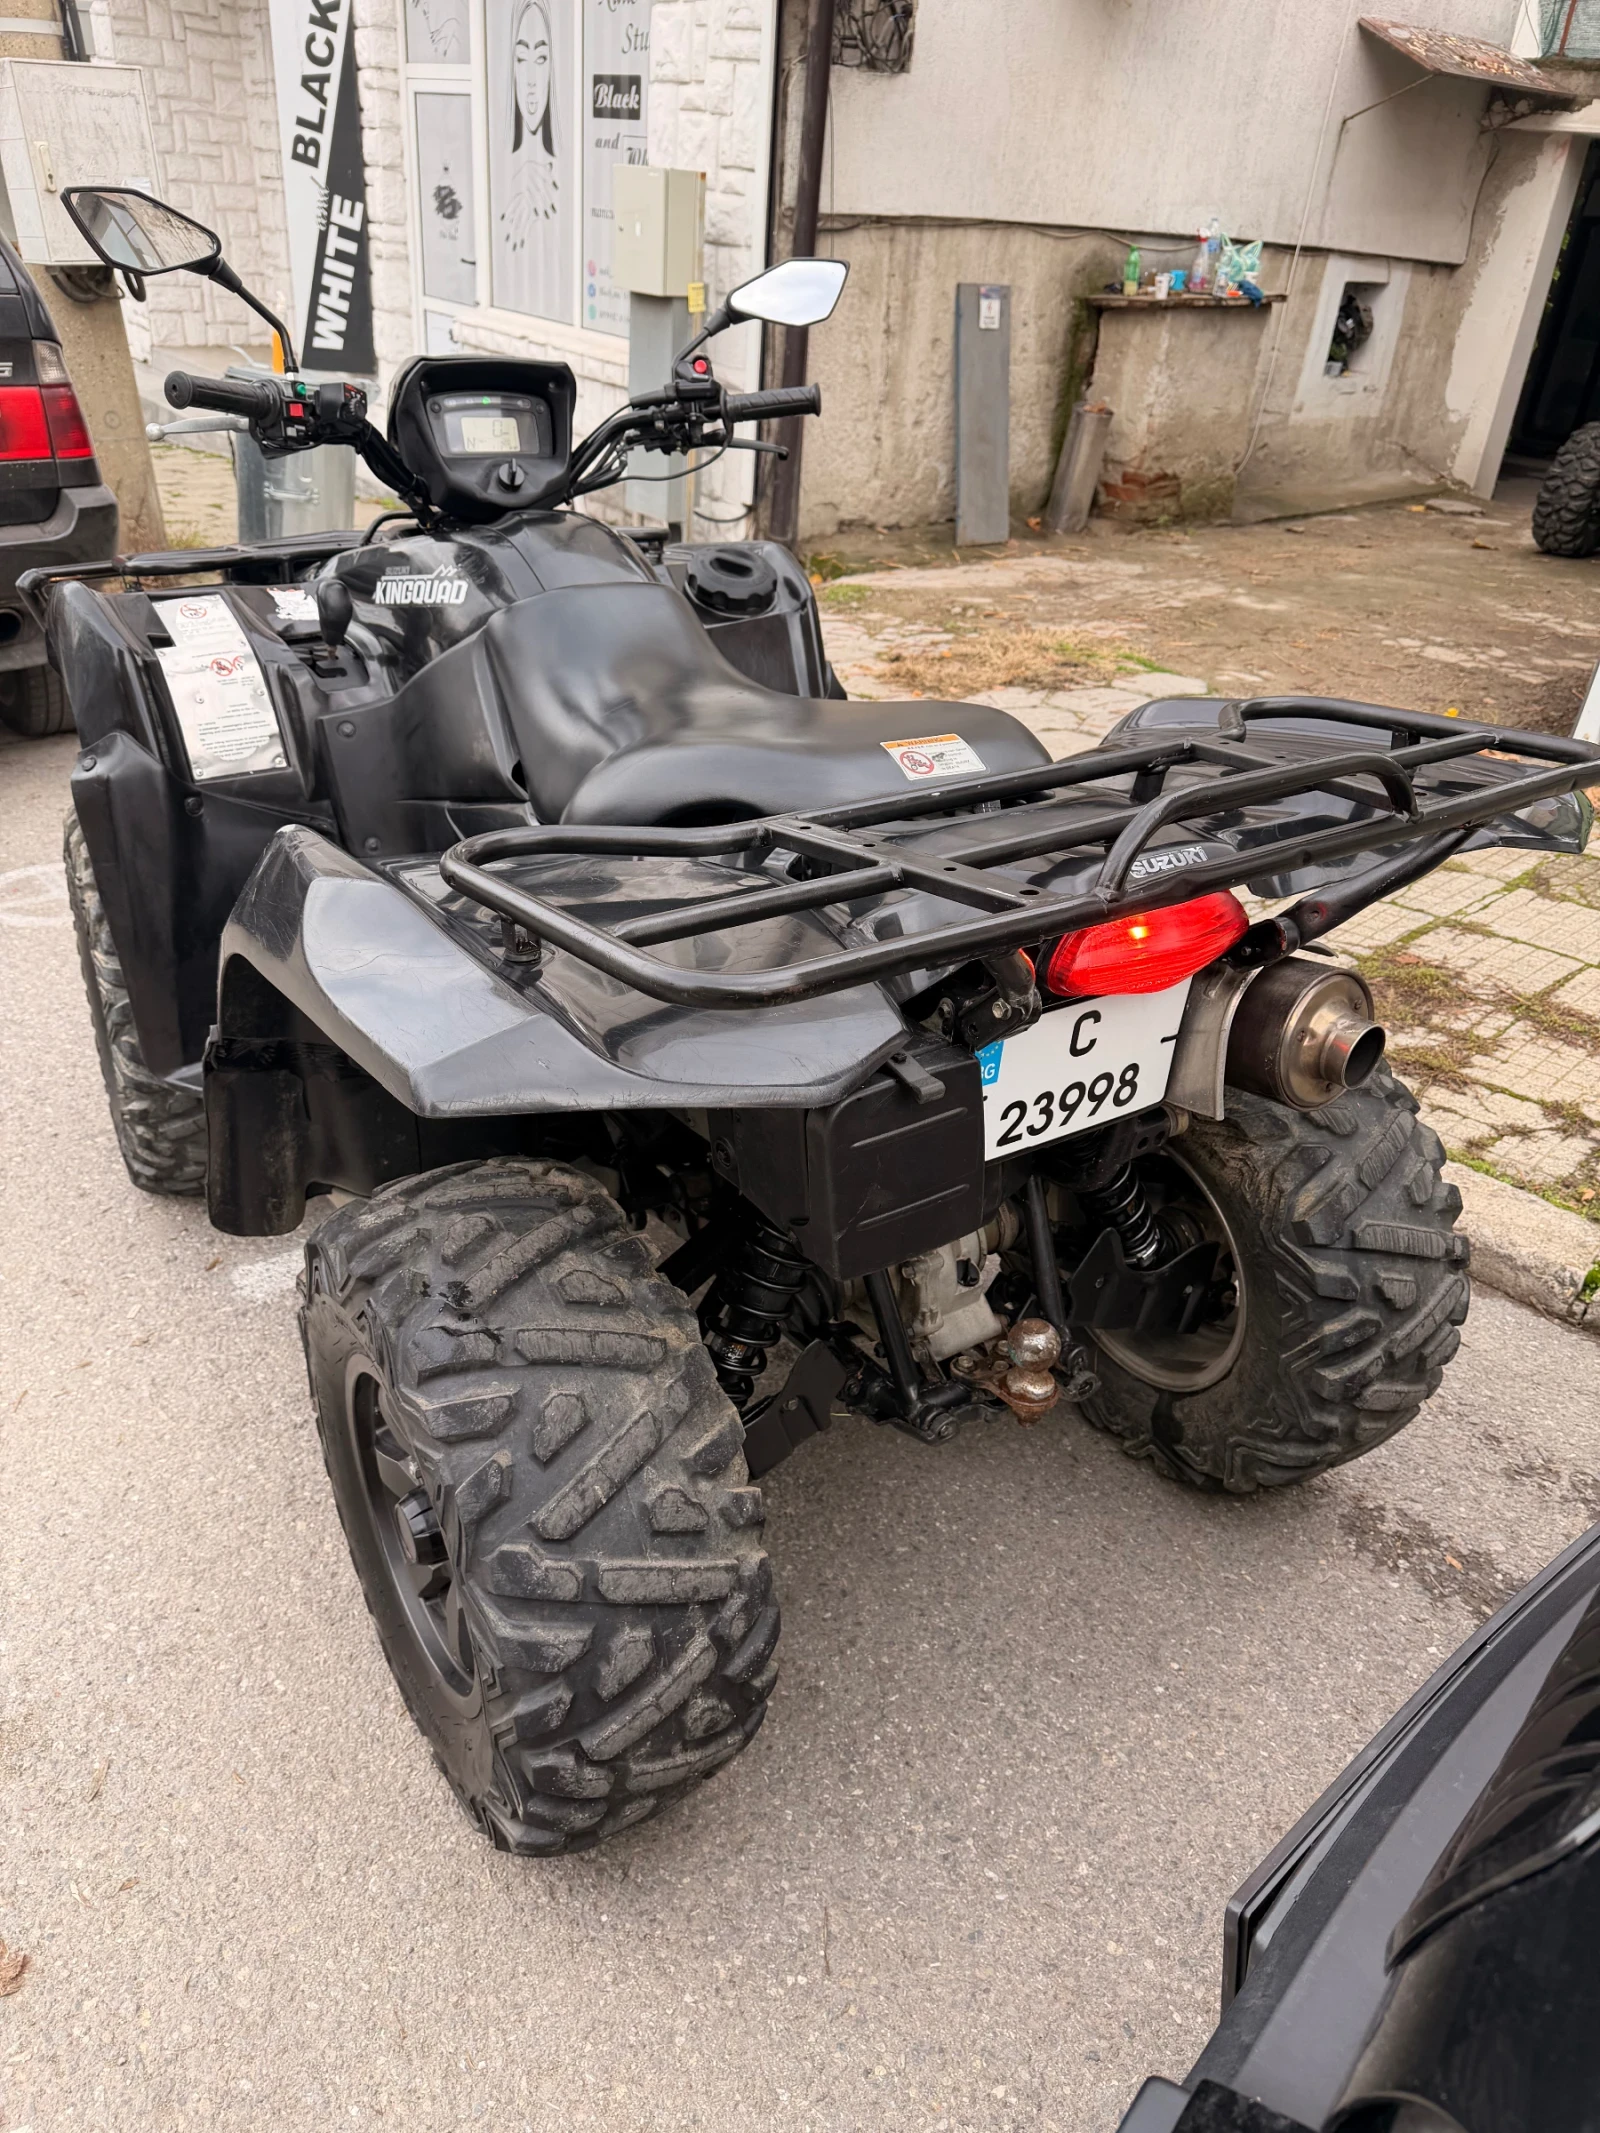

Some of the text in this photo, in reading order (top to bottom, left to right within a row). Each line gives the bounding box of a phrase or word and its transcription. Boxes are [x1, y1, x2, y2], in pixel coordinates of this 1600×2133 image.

[621, 22, 650, 55] Stu
[291, 0, 341, 169] BLACK
[594, 82, 640, 110] Black
[595, 132, 620, 150] and
[312, 194, 365, 351] WHITE
[385, 565, 411, 576] SUZUKI
[374, 579, 469, 605] KINGQUAD
[1130, 846, 1208, 878] SUZUKI
[1068, 1009, 1102, 1058] C
[996, 1062, 1140, 1147] 23998
